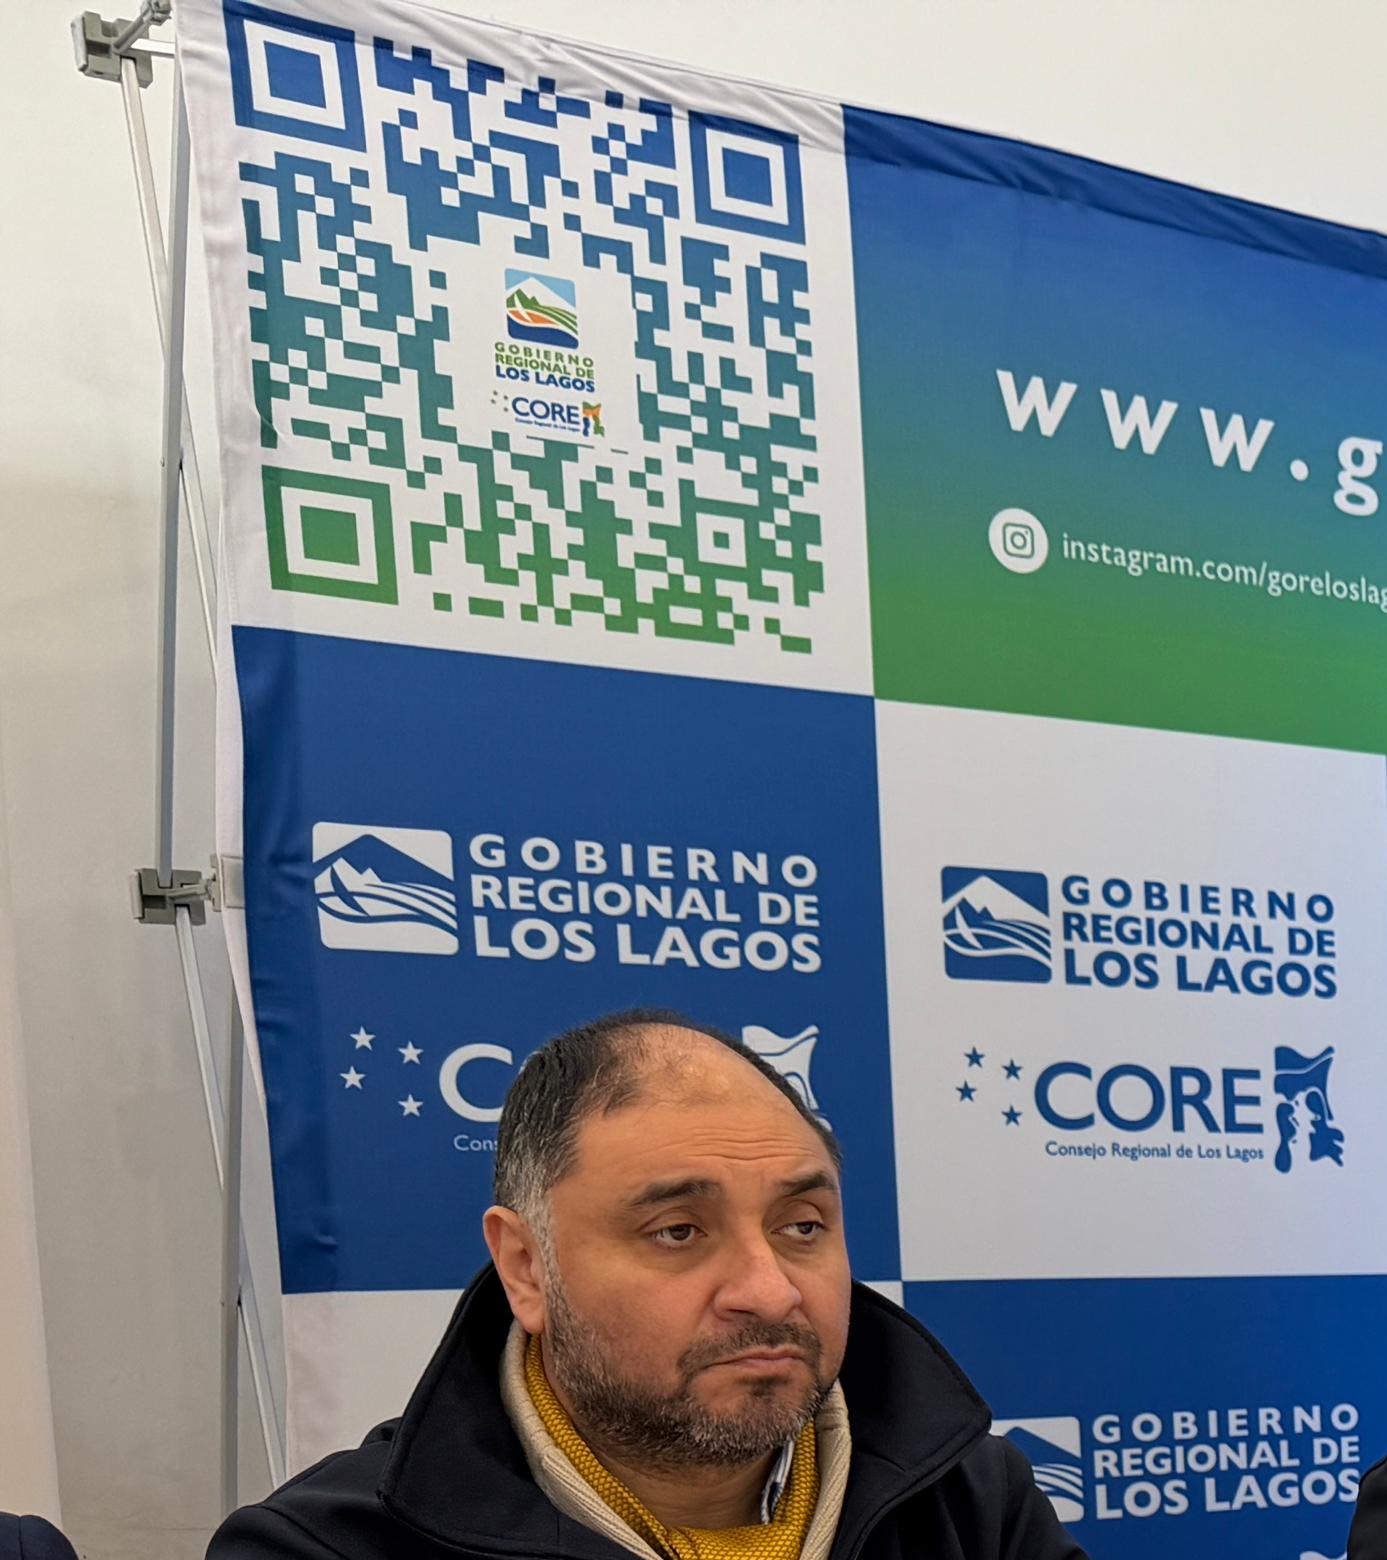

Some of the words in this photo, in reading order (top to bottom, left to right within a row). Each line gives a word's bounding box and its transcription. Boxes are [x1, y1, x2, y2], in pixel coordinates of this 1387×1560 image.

[495, 342, 594, 368] GOBIERNO
[495, 353, 571, 375] REGIONAL
[576, 367, 594, 379] DE
[496, 365, 530, 382] LOS
[535, 372, 595, 392] LAGOS
[512, 397, 580, 425] CORE
[469, 833, 817, 888] GOBIERNO
[470, 874, 740, 923] REGIONAL
[758, 893, 819, 926] DE
[1061, 875, 1334, 923] GOBIERNO
[473, 915, 596, 963] LOS
[618, 923, 821, 973] LAGOS
[1062, 911, 1273, 954] REGIONAL
[1288, 928, 1336, 958] DE
[1064, 948, 1159, 989] LOS
[1176, 955, 1337, 999] LAGOS
[1034, 1061, 1264, 1134] CORE
[1045, 1141, 1106, 1160] Consejo
[1111, 1142, 1171, 1162] Regional
[1176, 1144, 1193, 1159] de
[1198, 1145, 1221, 1159] Los
[1225, 1145, 1264, 1163] Lagos
[1092, 1403, 1359, 1444] GOBIERNO
[1093, 1439, 1300, 1479] REGIONAL
[1313, 1436, 1360, 1466] DE
[1095, 1480, 1189, 1520] LOS
[1204, 1469, 1361, 1513] LAGOS
